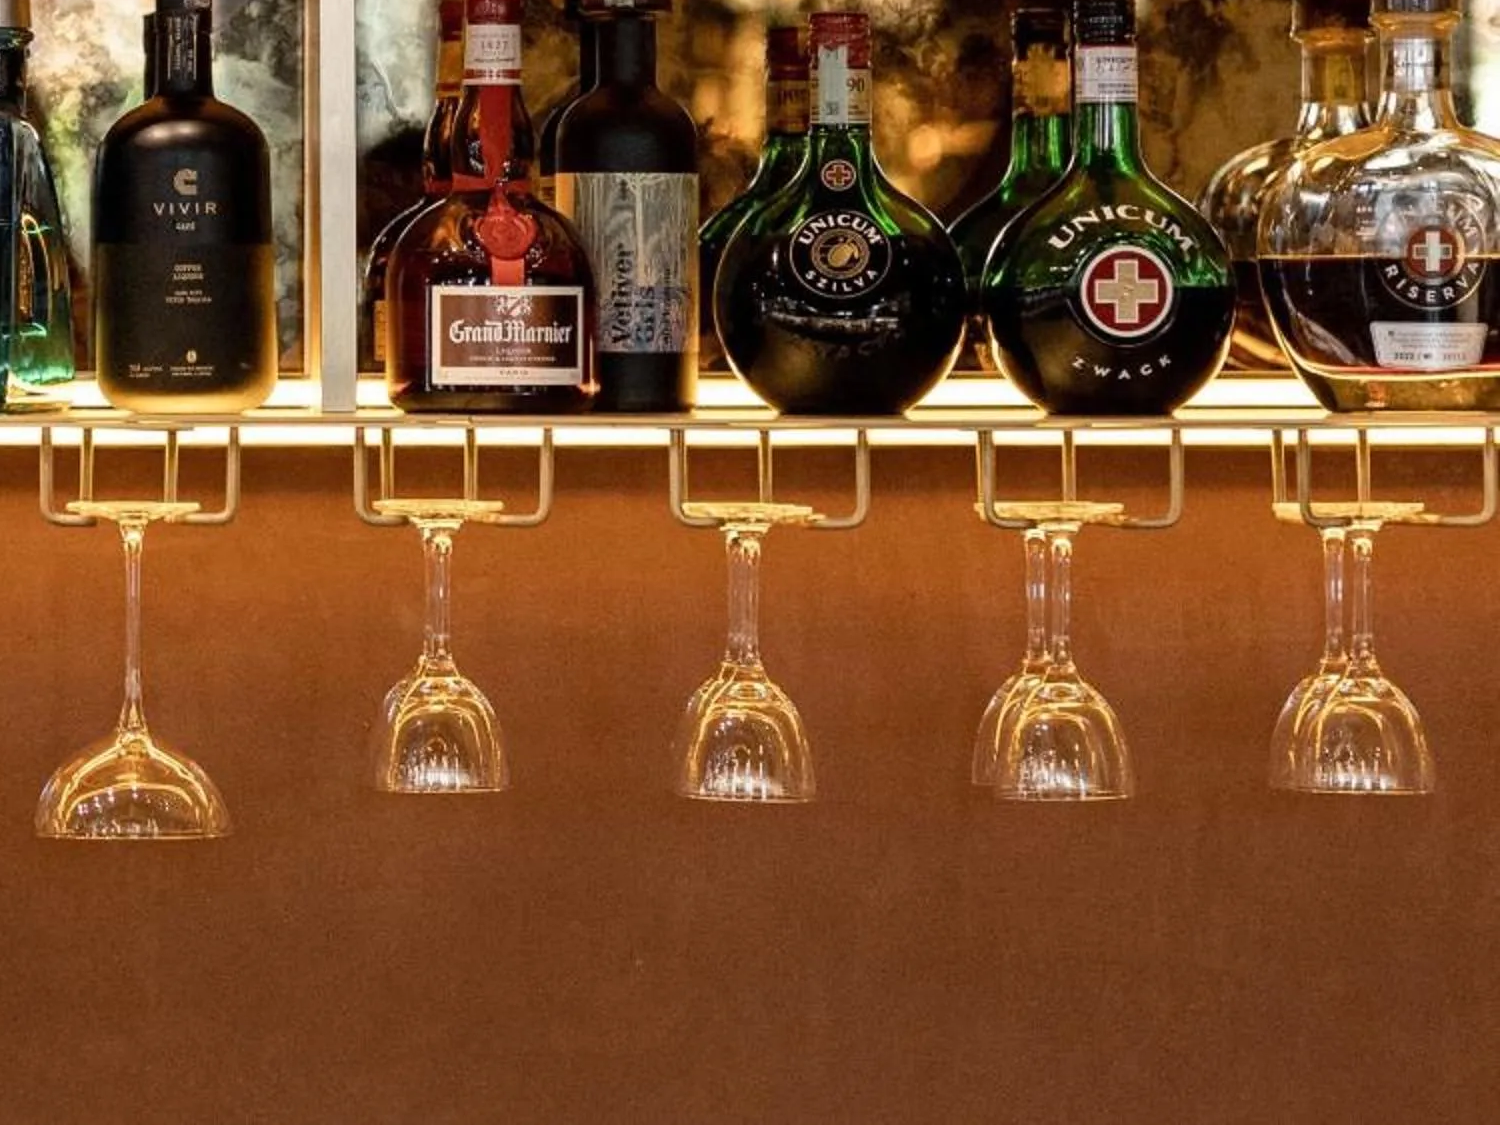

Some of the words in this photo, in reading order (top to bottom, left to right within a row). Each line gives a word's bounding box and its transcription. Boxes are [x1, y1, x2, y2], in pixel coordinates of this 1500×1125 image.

[152, 201, 218, 216] VIVIR
[798, 213, 882, 245] UNICUM
[1047, 204, 1197, 259] UNICUM
[805, 269, 879, 293] SZILVA
[1384, 261, 1480, 304] RISERVA
[448, 318, 503, 344] Grand
[503, 318, 573, 344] Marnier
[1072, 354, 1171, 380] ZWACK
